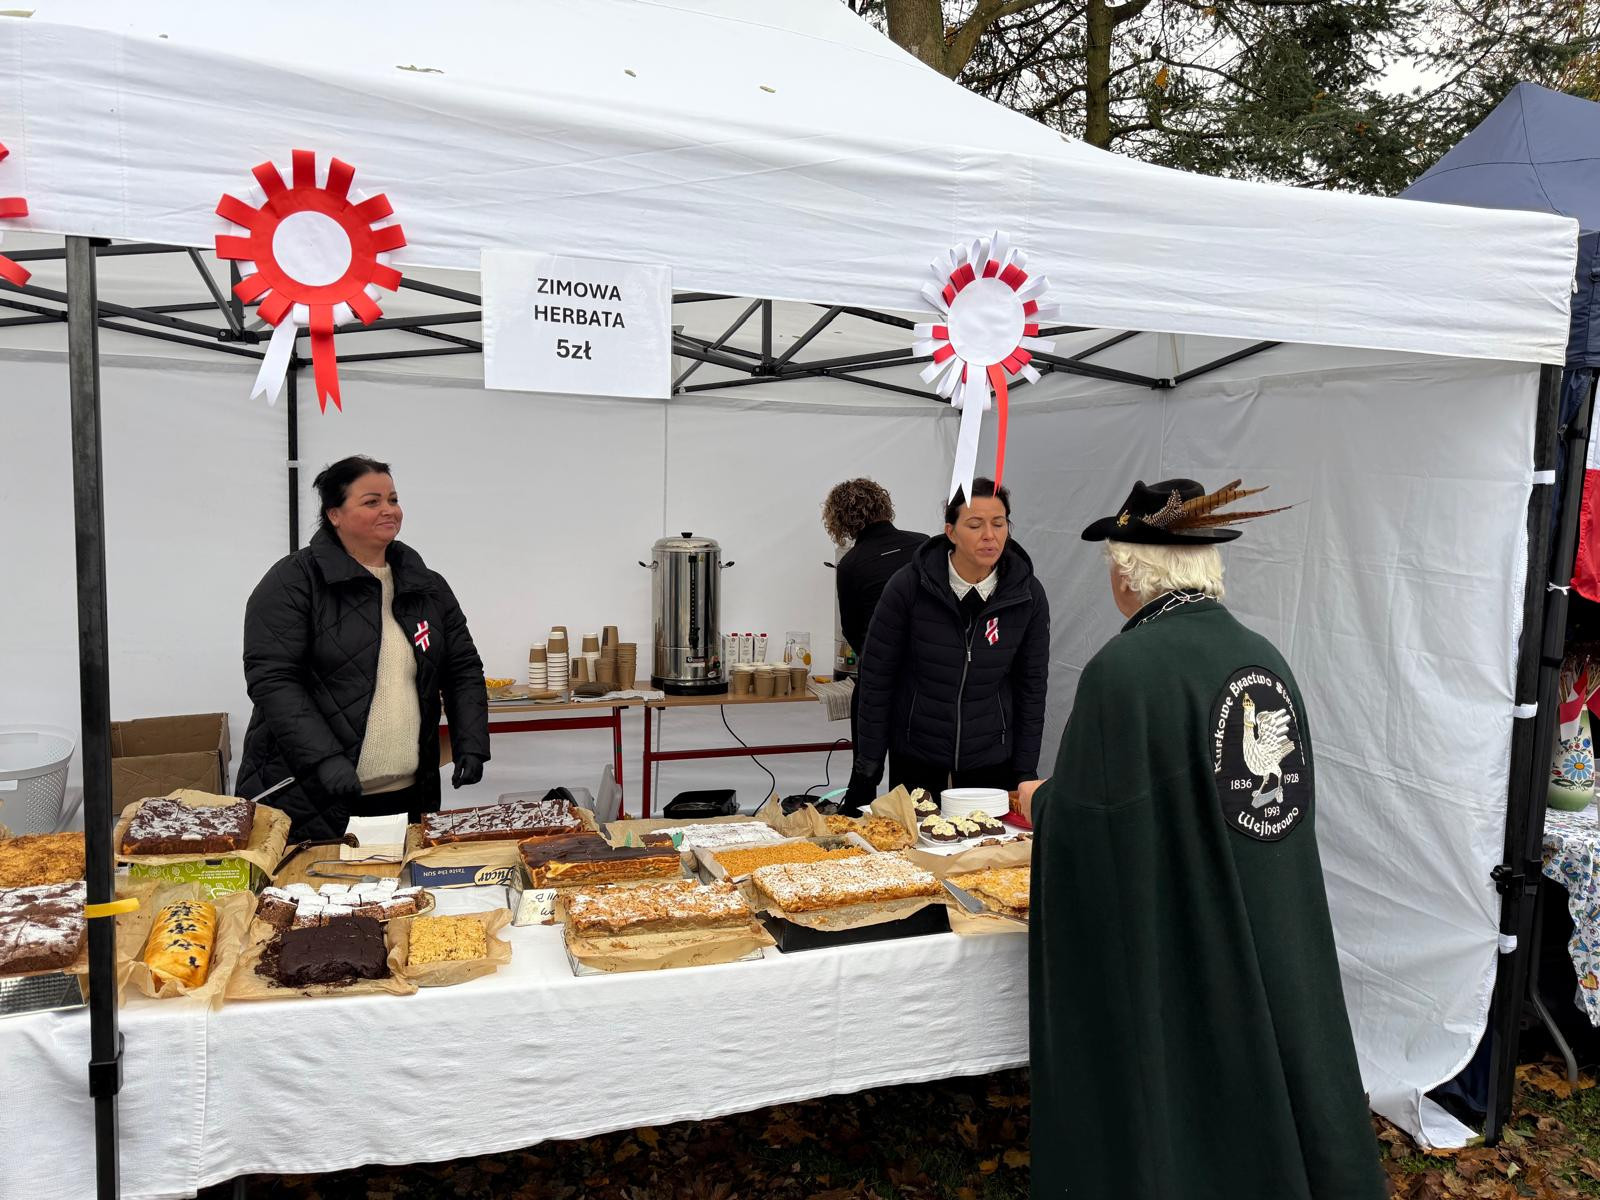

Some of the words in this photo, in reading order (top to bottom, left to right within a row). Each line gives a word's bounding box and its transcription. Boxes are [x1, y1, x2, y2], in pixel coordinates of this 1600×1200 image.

[537, 277, 622, 302] ZIMOWA
[534, 304, 626, 329] HERBATA
[556, 338, 592, 360] 5zł
[1214, 696, 1234, 774] Kurkowe
[1229, 672, 1272, 698] Bractwo
[1230, 779, 1253, 790] 1836
[1283, 773, 1300, 784] 1928
[1238, 807, 1299, 837] Wejherowo
[1264, 806, 1280, 818] 1993
